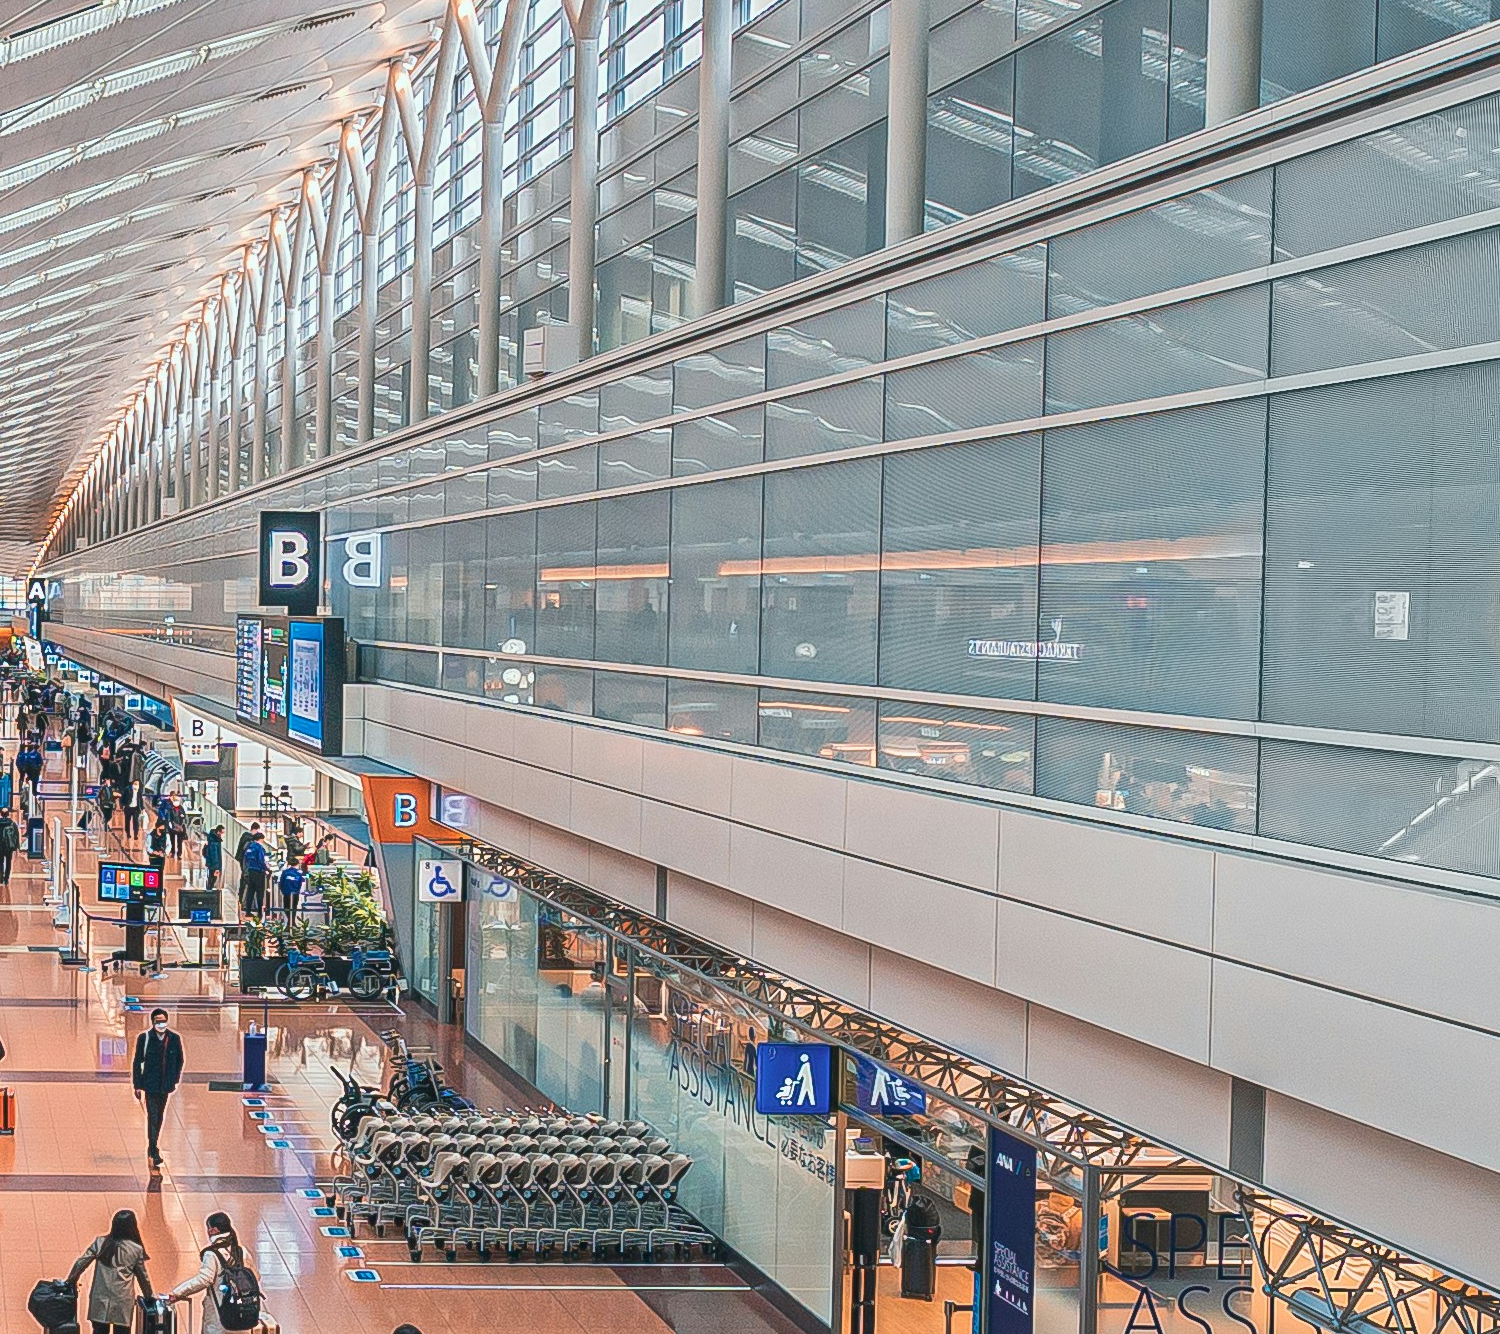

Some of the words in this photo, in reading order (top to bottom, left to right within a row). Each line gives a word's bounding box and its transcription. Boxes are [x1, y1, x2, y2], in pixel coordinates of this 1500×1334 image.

[270, 530, 309, 588] B
[28, 581, 46, 600] A
[192, 719, 204, 736] B
[394, 793, 417, 827] B
[996, 1152, 1014, 1173] ANA
